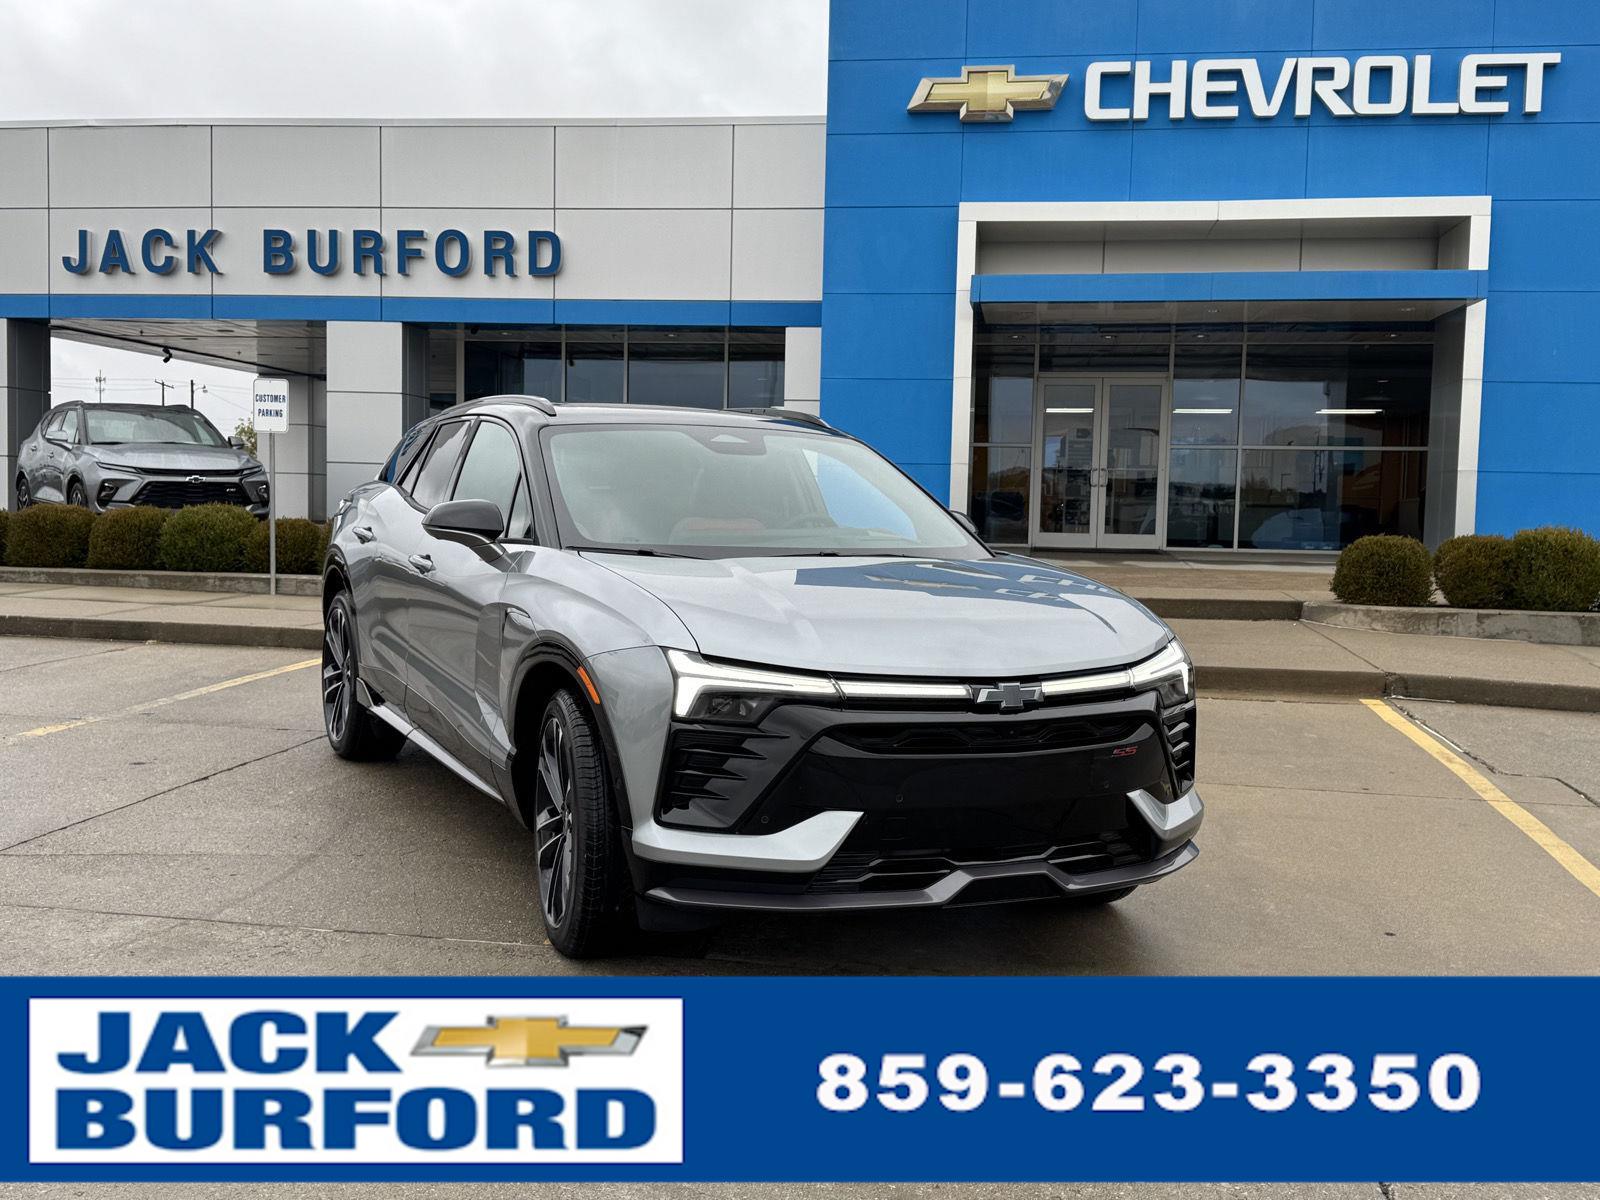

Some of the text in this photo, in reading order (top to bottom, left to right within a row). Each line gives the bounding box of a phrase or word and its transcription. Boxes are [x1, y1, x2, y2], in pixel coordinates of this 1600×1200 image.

[1084, 52, 1562, 122] CHEVROLET
[62, 229, 563, 278] JACK BURFORD
[255, 394, 286, 403] CUSTOMER
[258, 409, 283, 418] PARKING
